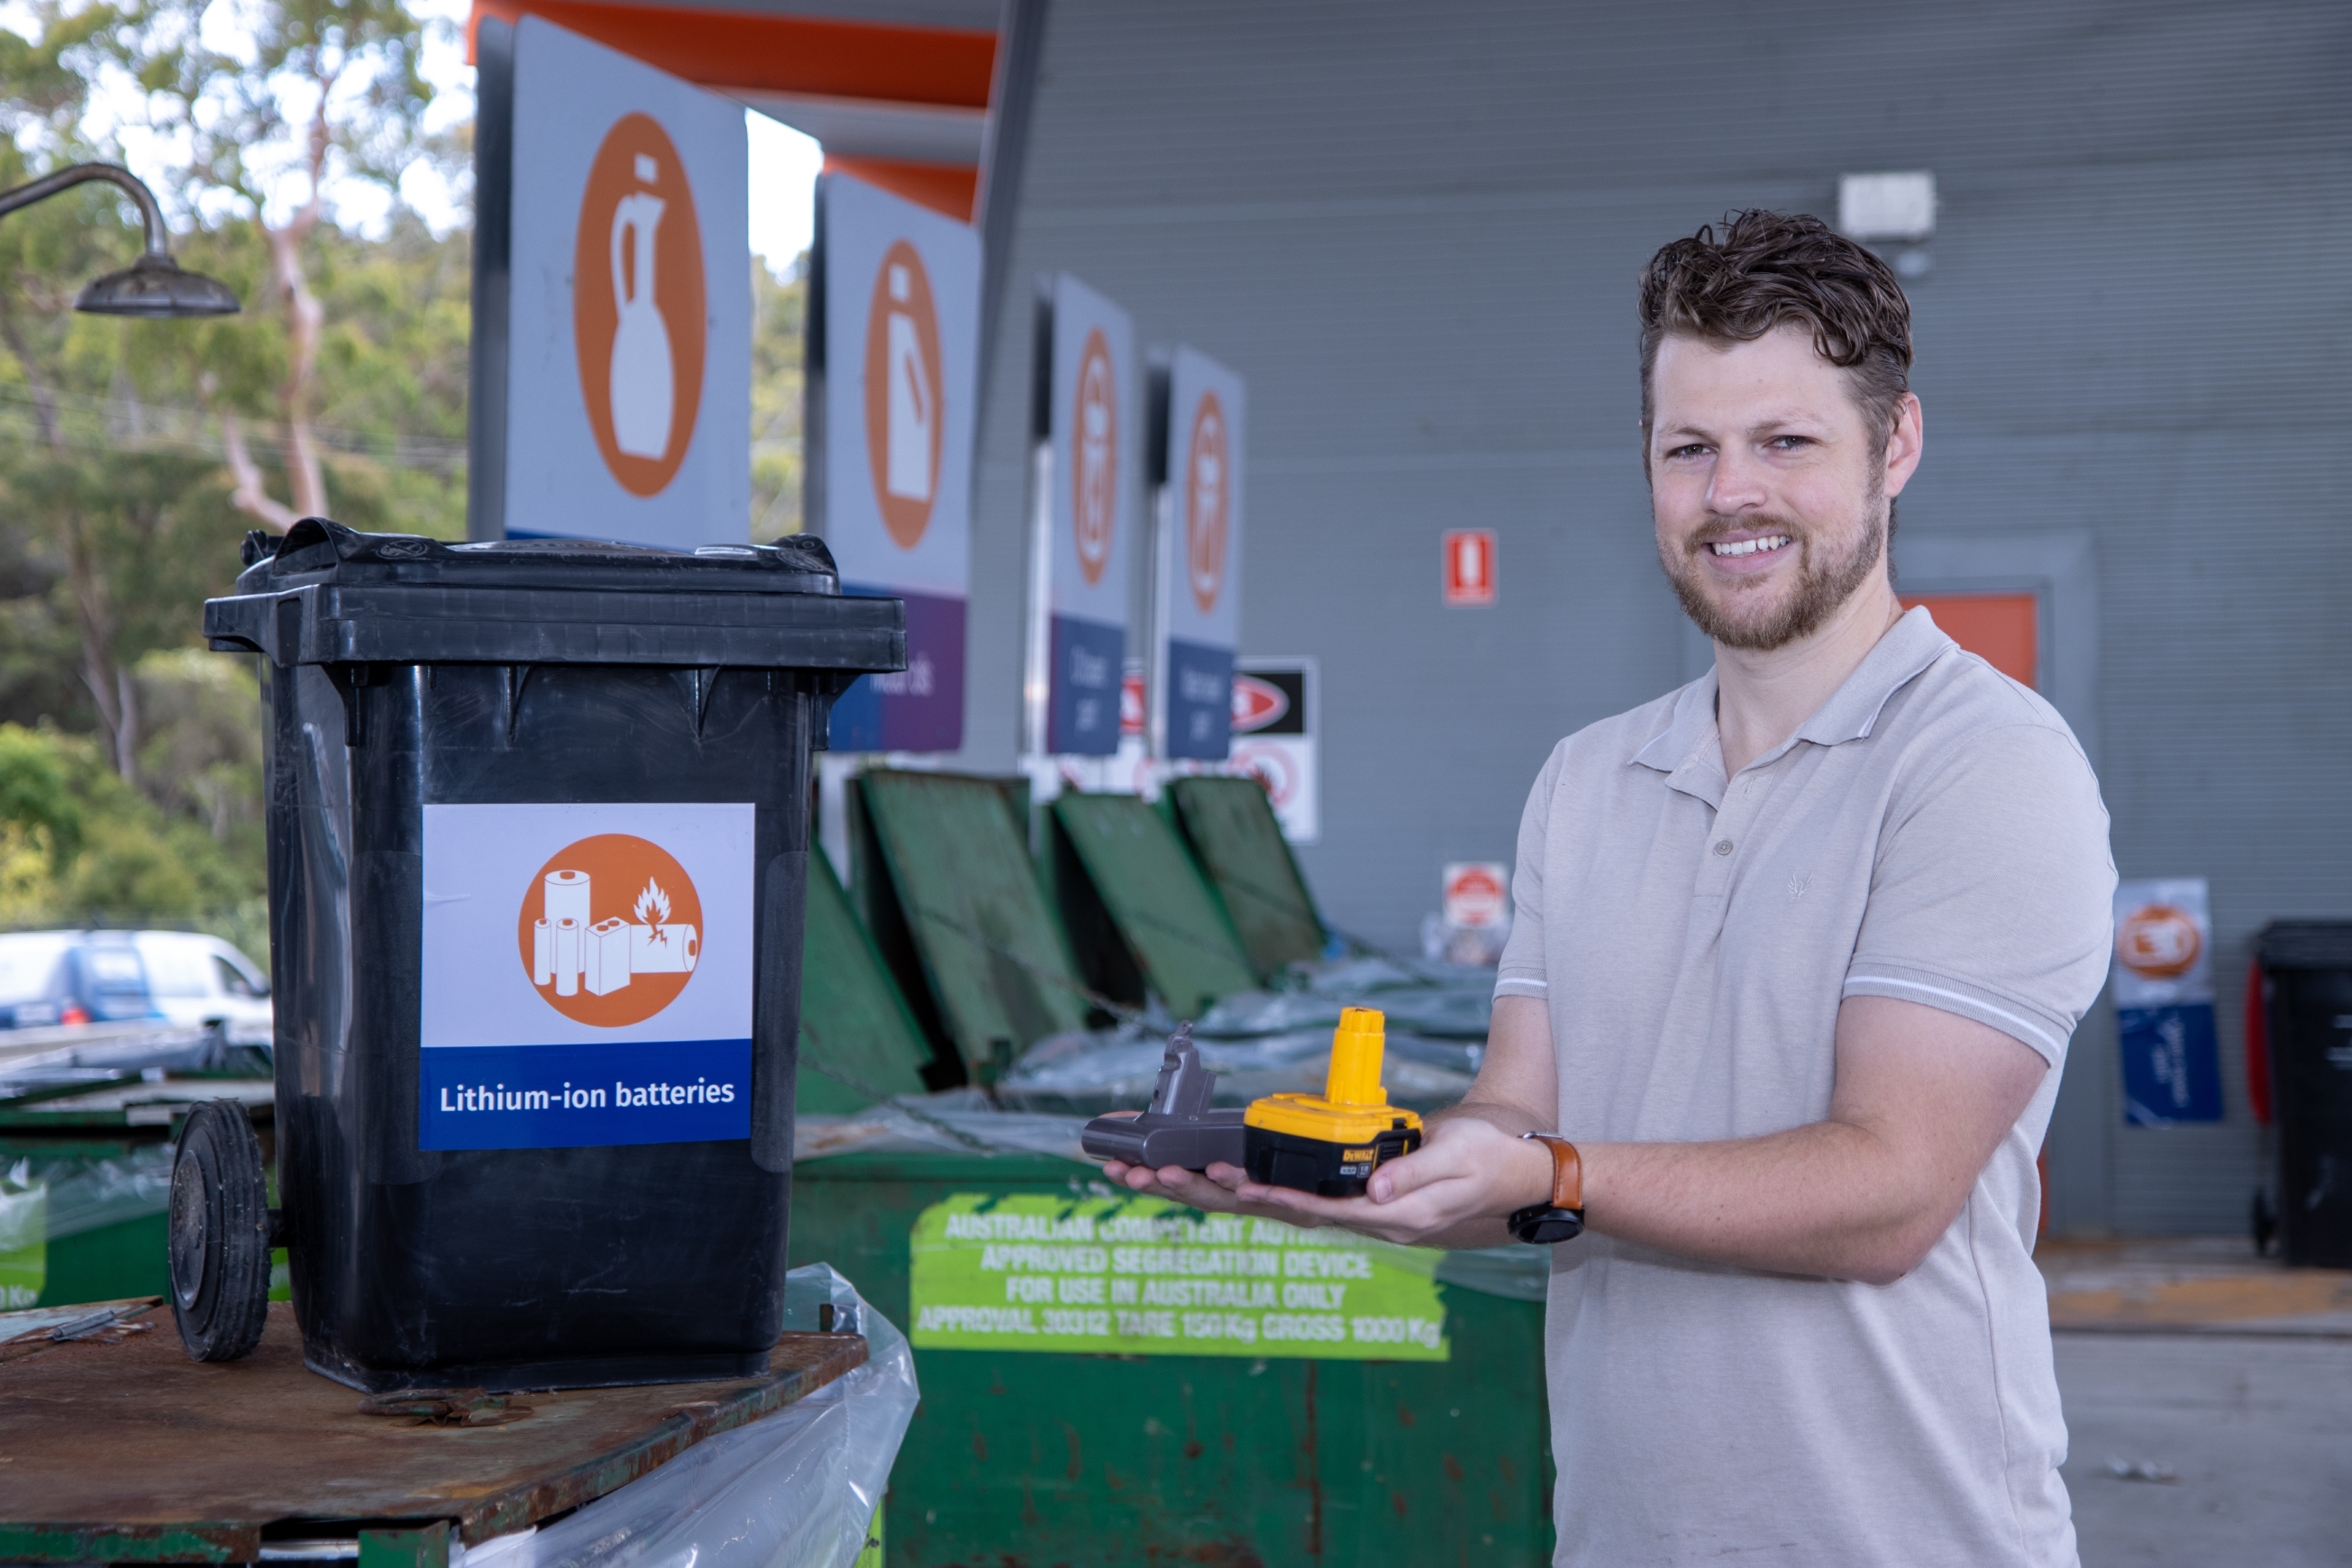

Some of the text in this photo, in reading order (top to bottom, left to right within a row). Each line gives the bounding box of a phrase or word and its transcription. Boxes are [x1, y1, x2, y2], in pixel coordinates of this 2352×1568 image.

[440, 1077, 735, 1113] Lithium-ion batteries
[944, 1213, 1094, 1241] AUSTRALIAN
[980, 1244, 1372, 1279] APPROVED SEGREGATION DEVICE
[1006, 1276, 1346, 1310] FOR USE IN AUSTRALIA ONLY
[917, 1305, 1037, 1333] APPROVAL
[1114, 1310, 1177, 1337] TARE
[1262, 1314, 1346, 1341] GROSS
